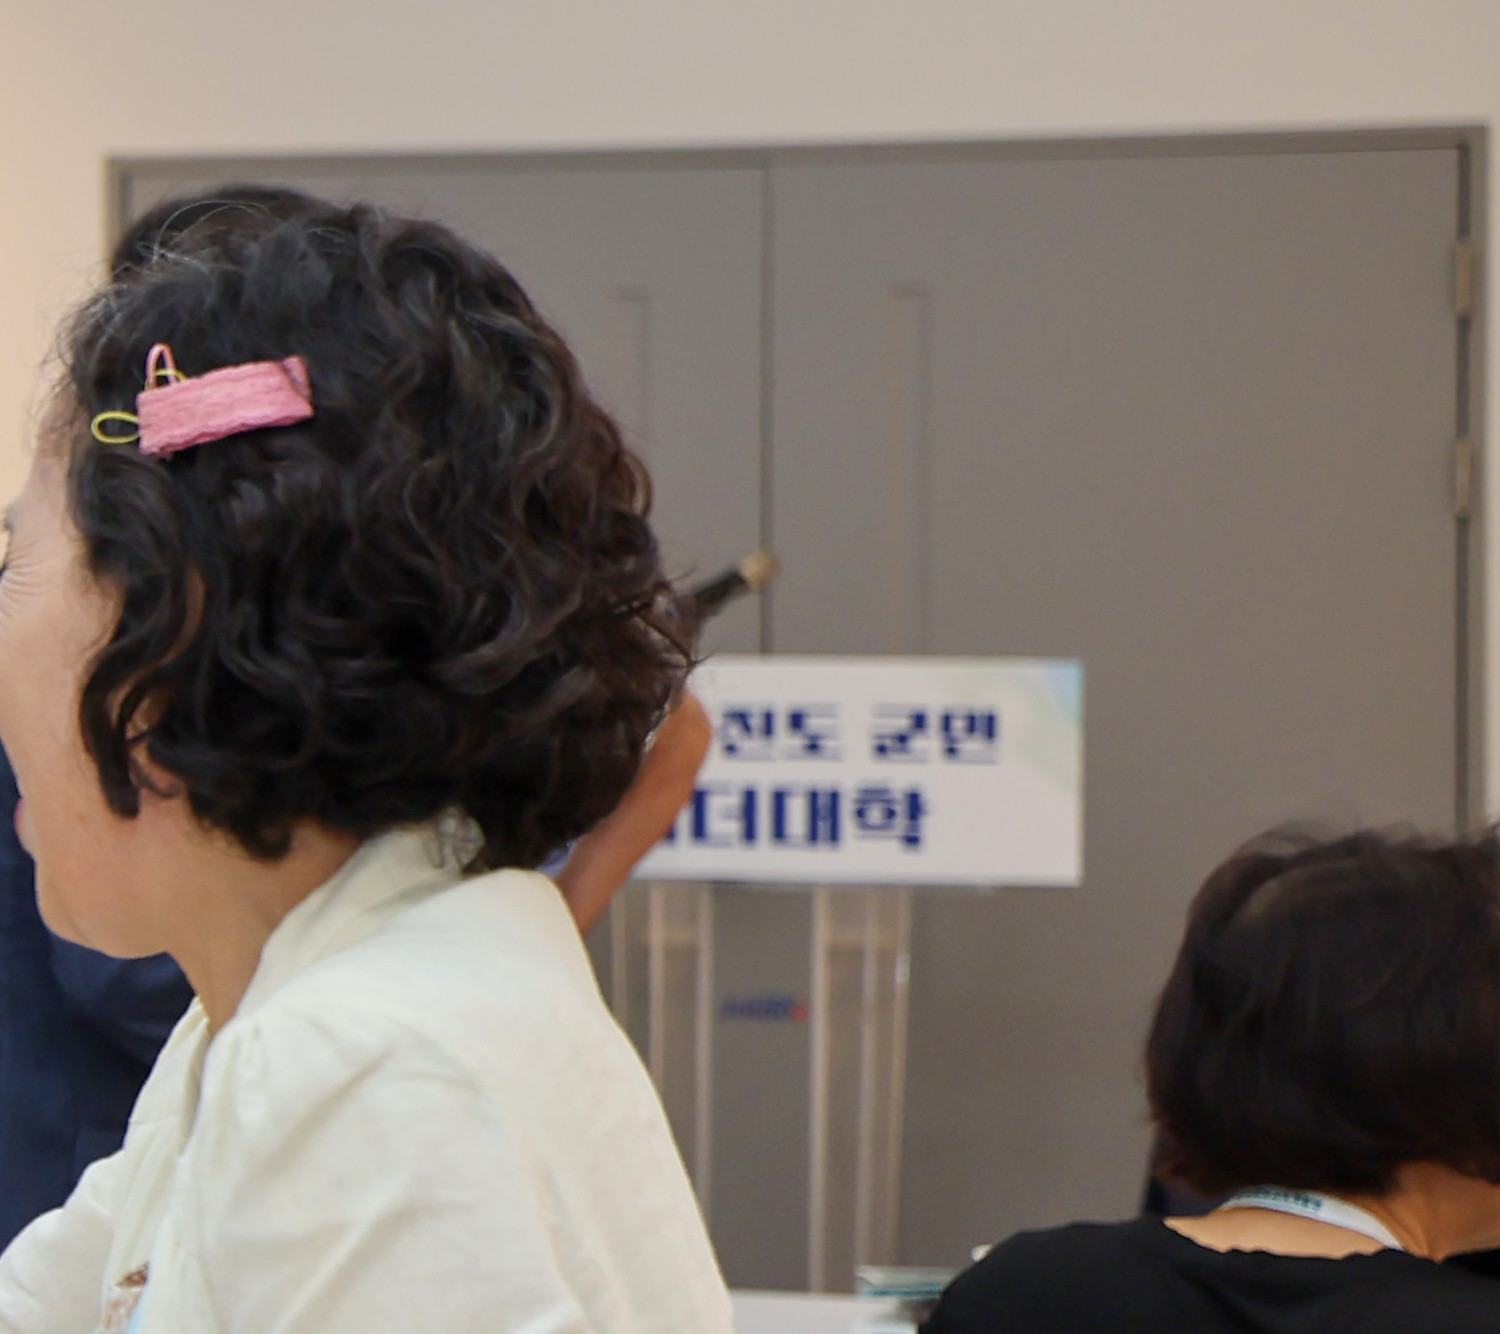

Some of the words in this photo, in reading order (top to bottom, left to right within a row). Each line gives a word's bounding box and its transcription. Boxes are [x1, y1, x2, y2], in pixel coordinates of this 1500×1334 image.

[720, 702, 844, 763] 진도
[872, 701, 1000, 766] 군민
[666, 782, 928, 851] 더대학
